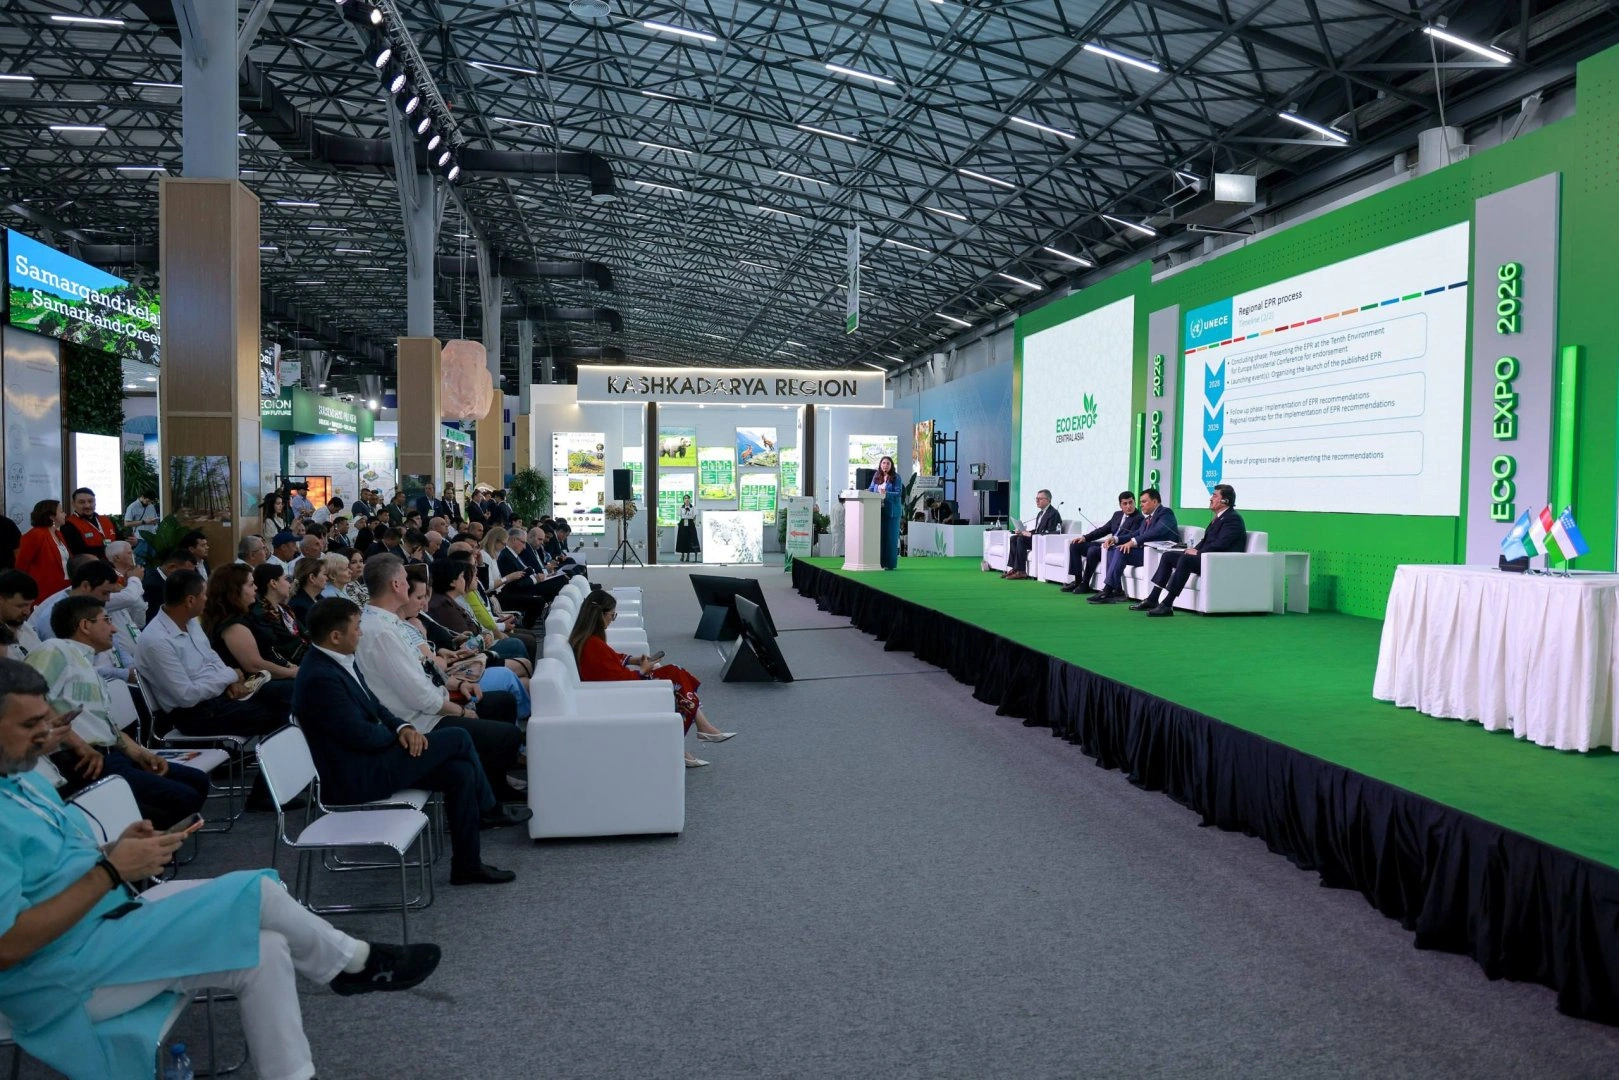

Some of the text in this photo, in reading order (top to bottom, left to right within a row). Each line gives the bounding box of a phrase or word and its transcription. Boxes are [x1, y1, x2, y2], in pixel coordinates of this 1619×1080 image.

[15, 254, 160, 329] Samarqand:kela
[1239, 291, 1303, 316] Regional EPR process
[32, 289, 160, 345] Samarkand:Gree
[1203, 315, 1229, 330] UNECE
[1269, 346, 1294, 358] Presenting
[1303, 342, 1314, 351] EPR
[1320, 339, 1330, 347] the
[1331, 335, 1346, 345] Tenth
[1347, 327, 1385, 341] Environment
[1276, 354, 1304, 366] Conference
[1304, 352, 1312, 360] for
[1312, 346, 1348, 359] endorsement
[1296, 365, 1305, 373] the
[1305, 361, 1323, 372] launch
[1323, 360, 1330, 368] of
[1330, 359, 1340, 367] the
[1340, 353, 1369, 366] published
[1370, 351, 1382, 360] EPR
[1153, 354, 1165, 397] 2026
[607, 376, 857, 397] KASHKADARYA REGION
[1490, 262, 1522, 522] ECO EXPO 2026
[1265, 401, 1302, 411] Implementation
[1302, 399, 1309, 407] of
[1309, 398, 1319, 406] EPR
[1319, 392, 1370, 404] recommendations
[1283, 407, 1323, 419] implementation
[1323, 406, 1330, 414] of
[1330, 405, 1341, 413] EPR
[1341, 400, 1396, 412] recommendations
[1056, 413, 1093, 433] ECO EXPO
[1056, 431, 1085, 443] CENTRAL ASIA
[1151, 410, 1163, 461] EXPO
[1286, 454, 1321, 463] implementing
[1321, 452, 1331, 461] the
[1331, 451, 1384, 461] recommendations
